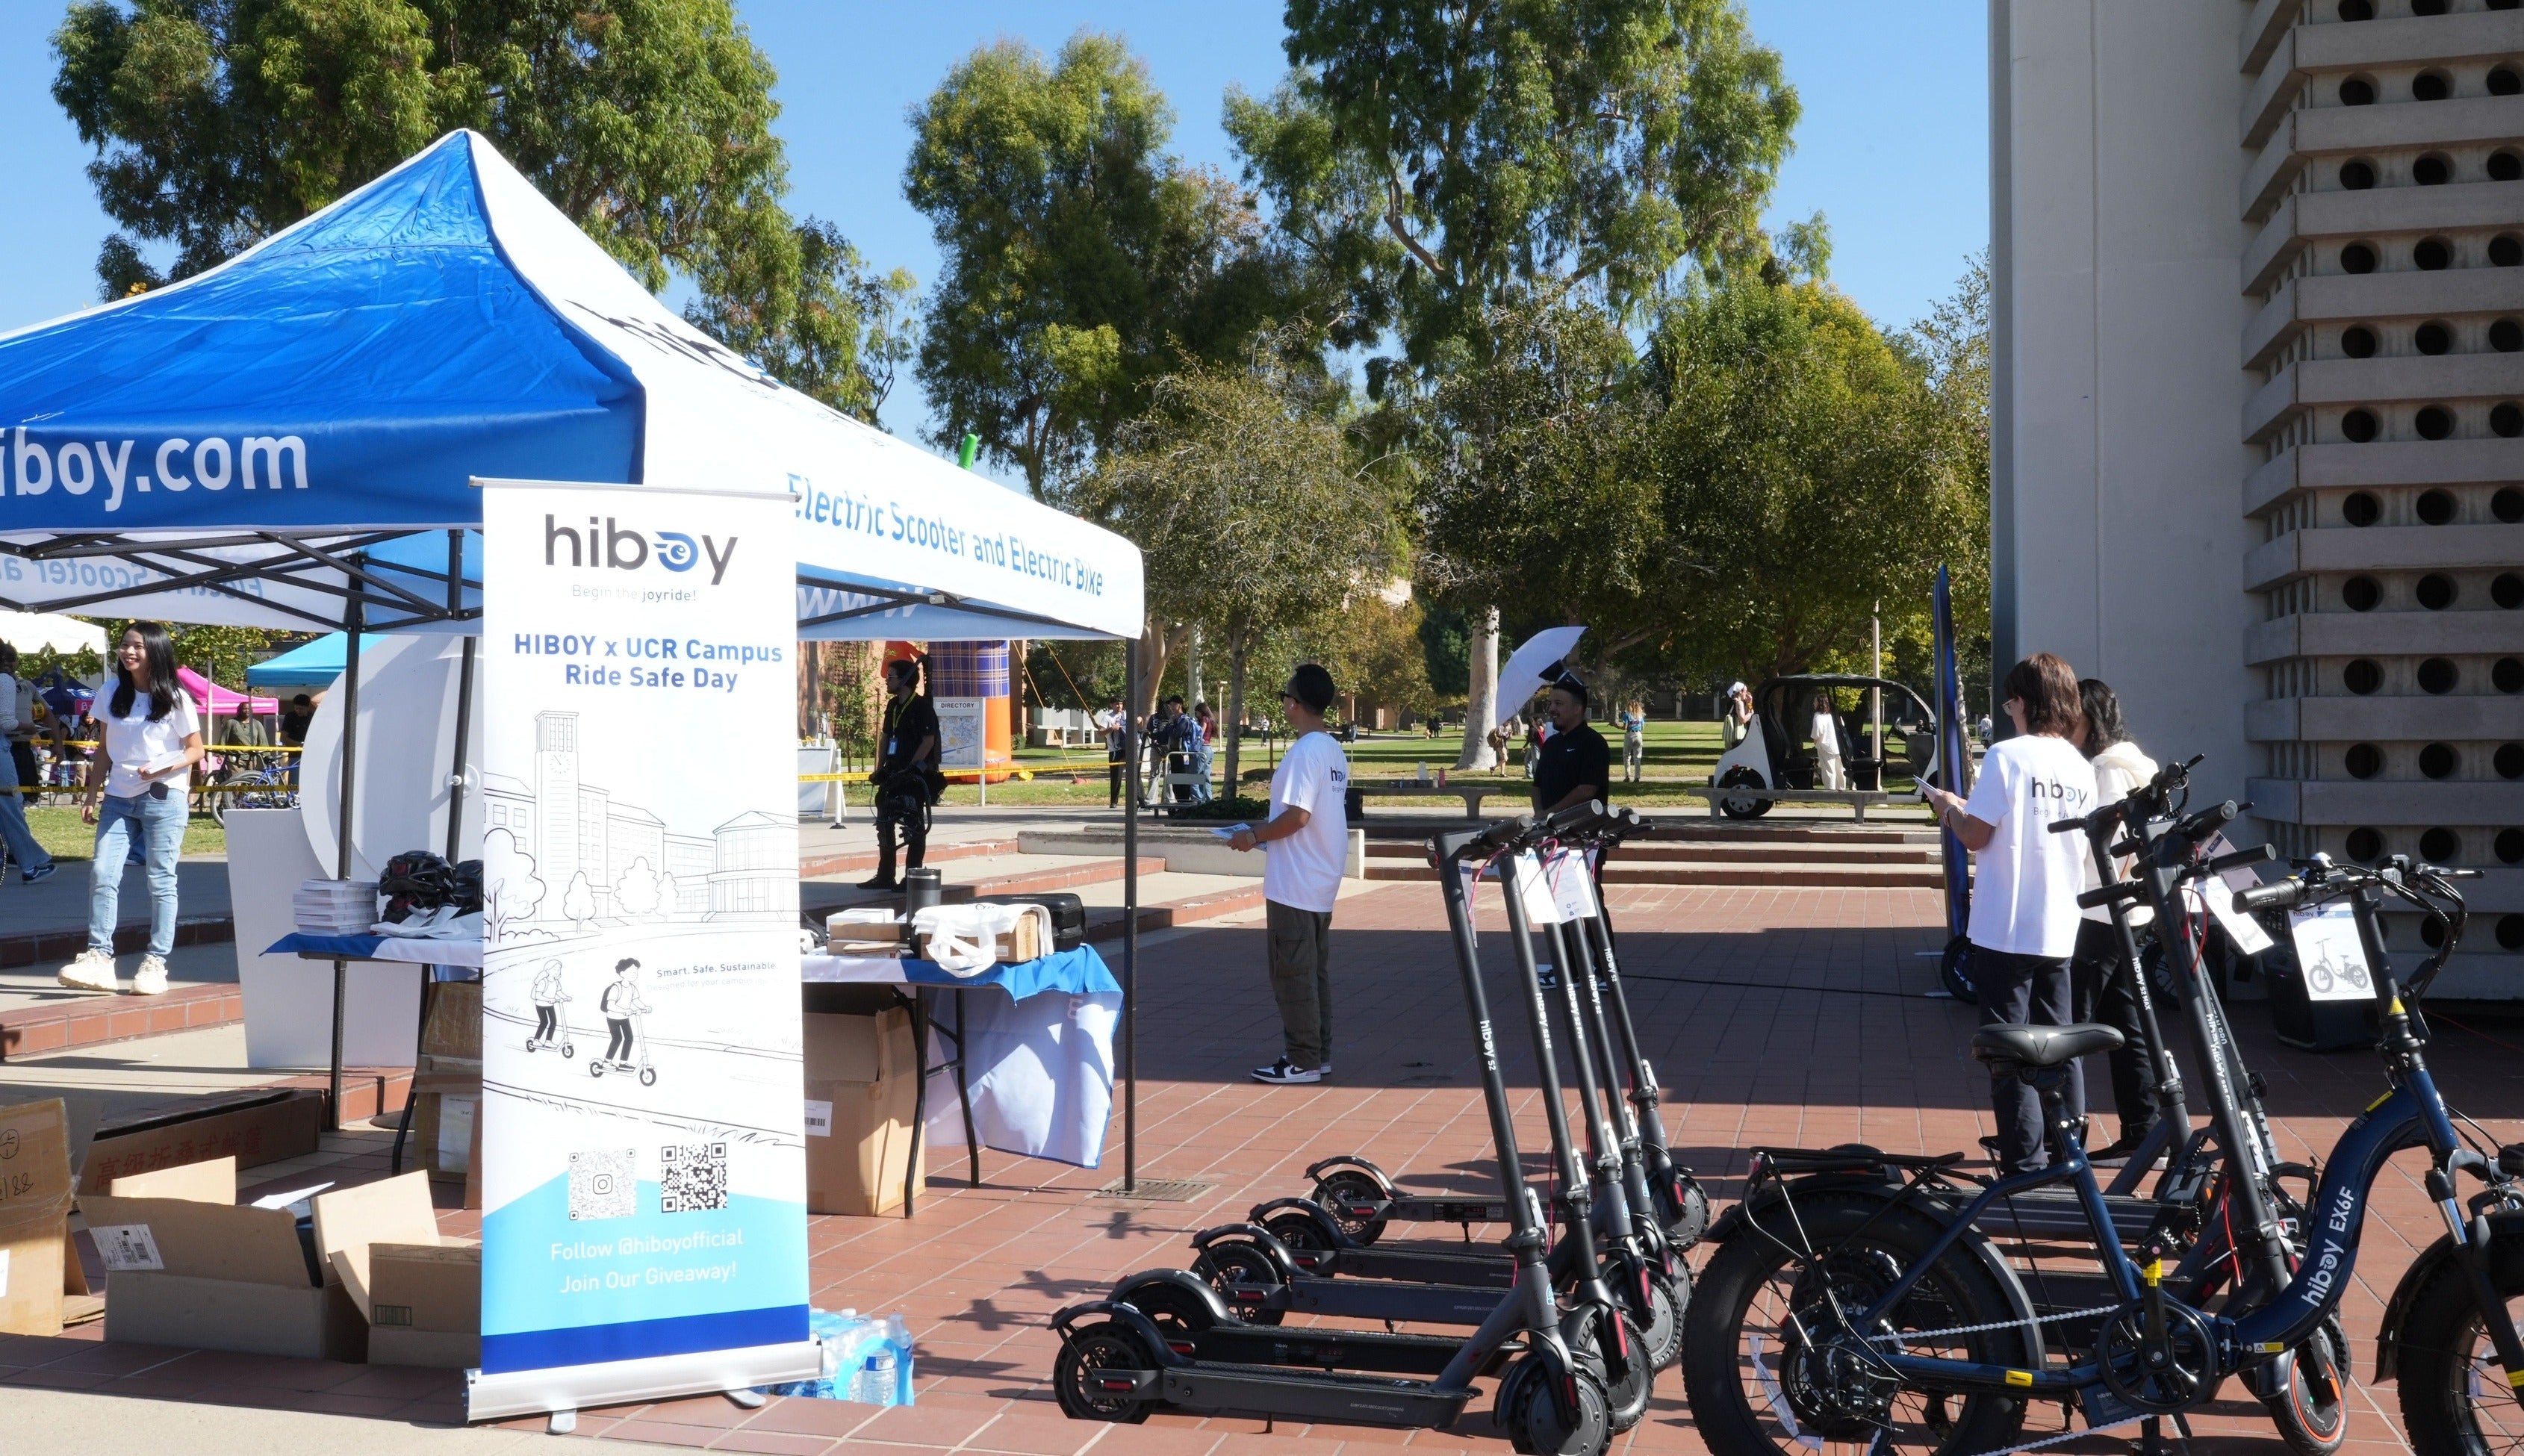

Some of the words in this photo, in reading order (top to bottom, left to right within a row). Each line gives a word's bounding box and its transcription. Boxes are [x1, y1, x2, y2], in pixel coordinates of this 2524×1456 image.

[544, 513, 739, 586] hiboy
[786, 472, 885, 537] Electric
[889, 501, 966, 557] Scooter
[972, 532, 1005, 567] and
[1011, 535, 1072, 587] Electric
[1076, 557, 1104, 597] Bike
[572, 584, 612, 600] Begin
[641, 588, 696, 603] joyride!
[515, 632, 597, 656] HIBOY
[604, 641, 618, 657] x
[626, 638, 678, 659] UCR
[686, 639, 783, 665] Campus
[565, 663, 621, 685] Ride
[630, 666, 685, 688] Safe
[694, 668, 739, 693] Day
[656, 968, 690, 978] Smart.
[693, 965, 718, 974] Safe.
[720, 962, 778, 972] Sustainable.
[1604, 948, 1616, 974] hiboy
[2132, 956, 2145, 986] hiboy
[1567, 983, 1579, 1016] hiboy
[1588, 974, 1601, 1004] hiboy
[1595, 1005, 1602, 1014] S2
[2139, 986, 2147, 995] S2
[2142, 995, 2151, 1010] MAX
[1535, 992, 1548, 1027] hiboy
[1479, 1019, 1495, 1058] hiboy
[1488, 1060, 1496, 1071] S2
[2210, 1044, 2226, 1078] hiboy
[550, 1241, 613, 1261] Follow
[618, 1228, 744, 1255] @hiboyofficial
[2301, 1238, 2345, 1307] hiboy
[2328, 1186, 2354, 1233] EX6F
[560, 1274, 600, 1294] Join
[606, 1271, 641, 1289] Our
[645, 1260, 737, 1286] Giveaway!
